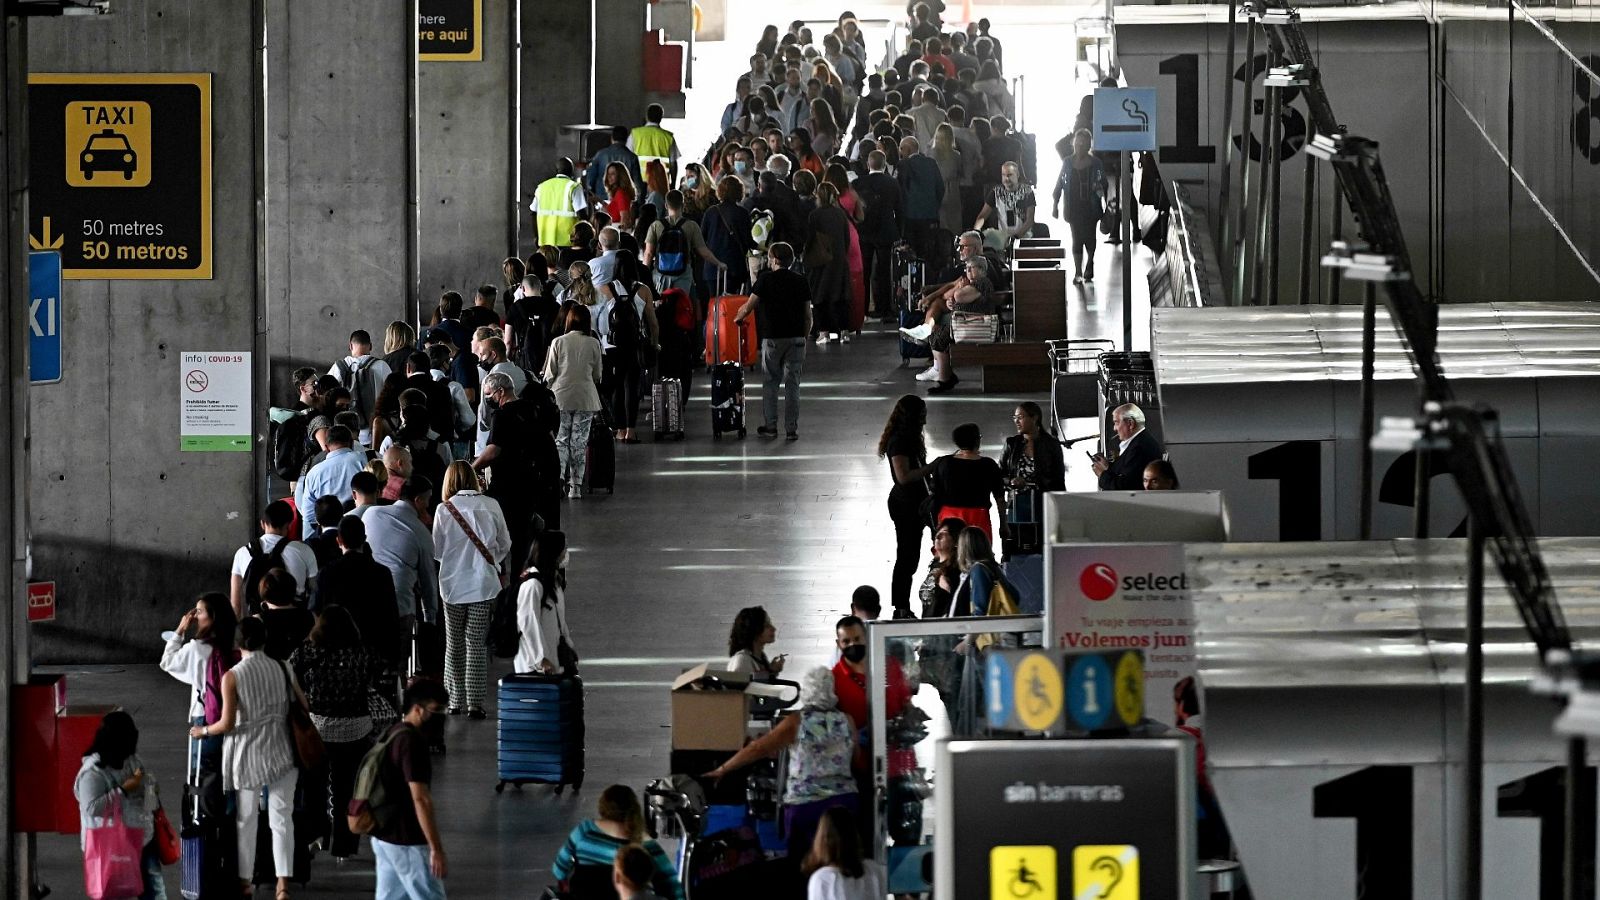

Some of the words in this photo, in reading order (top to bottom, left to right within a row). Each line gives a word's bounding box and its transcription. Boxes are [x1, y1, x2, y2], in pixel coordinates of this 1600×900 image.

[418, 30, 435, 40] re
[439, 28, 467, 43] aquí
[82, 106, 134, 125] TAXI
[1159, 54, 1306, 163] 13
[83, 219, 104, 236] 50
[109, 221, 164, 236] metres
[82, 241, 110, 260] 50
[116, 242, 188, 260] metros
[185, 354, 203, 363] info
[1060, 632, 1150, 649] ¡Volemos
[1153, 632, 1192, 649] jun
